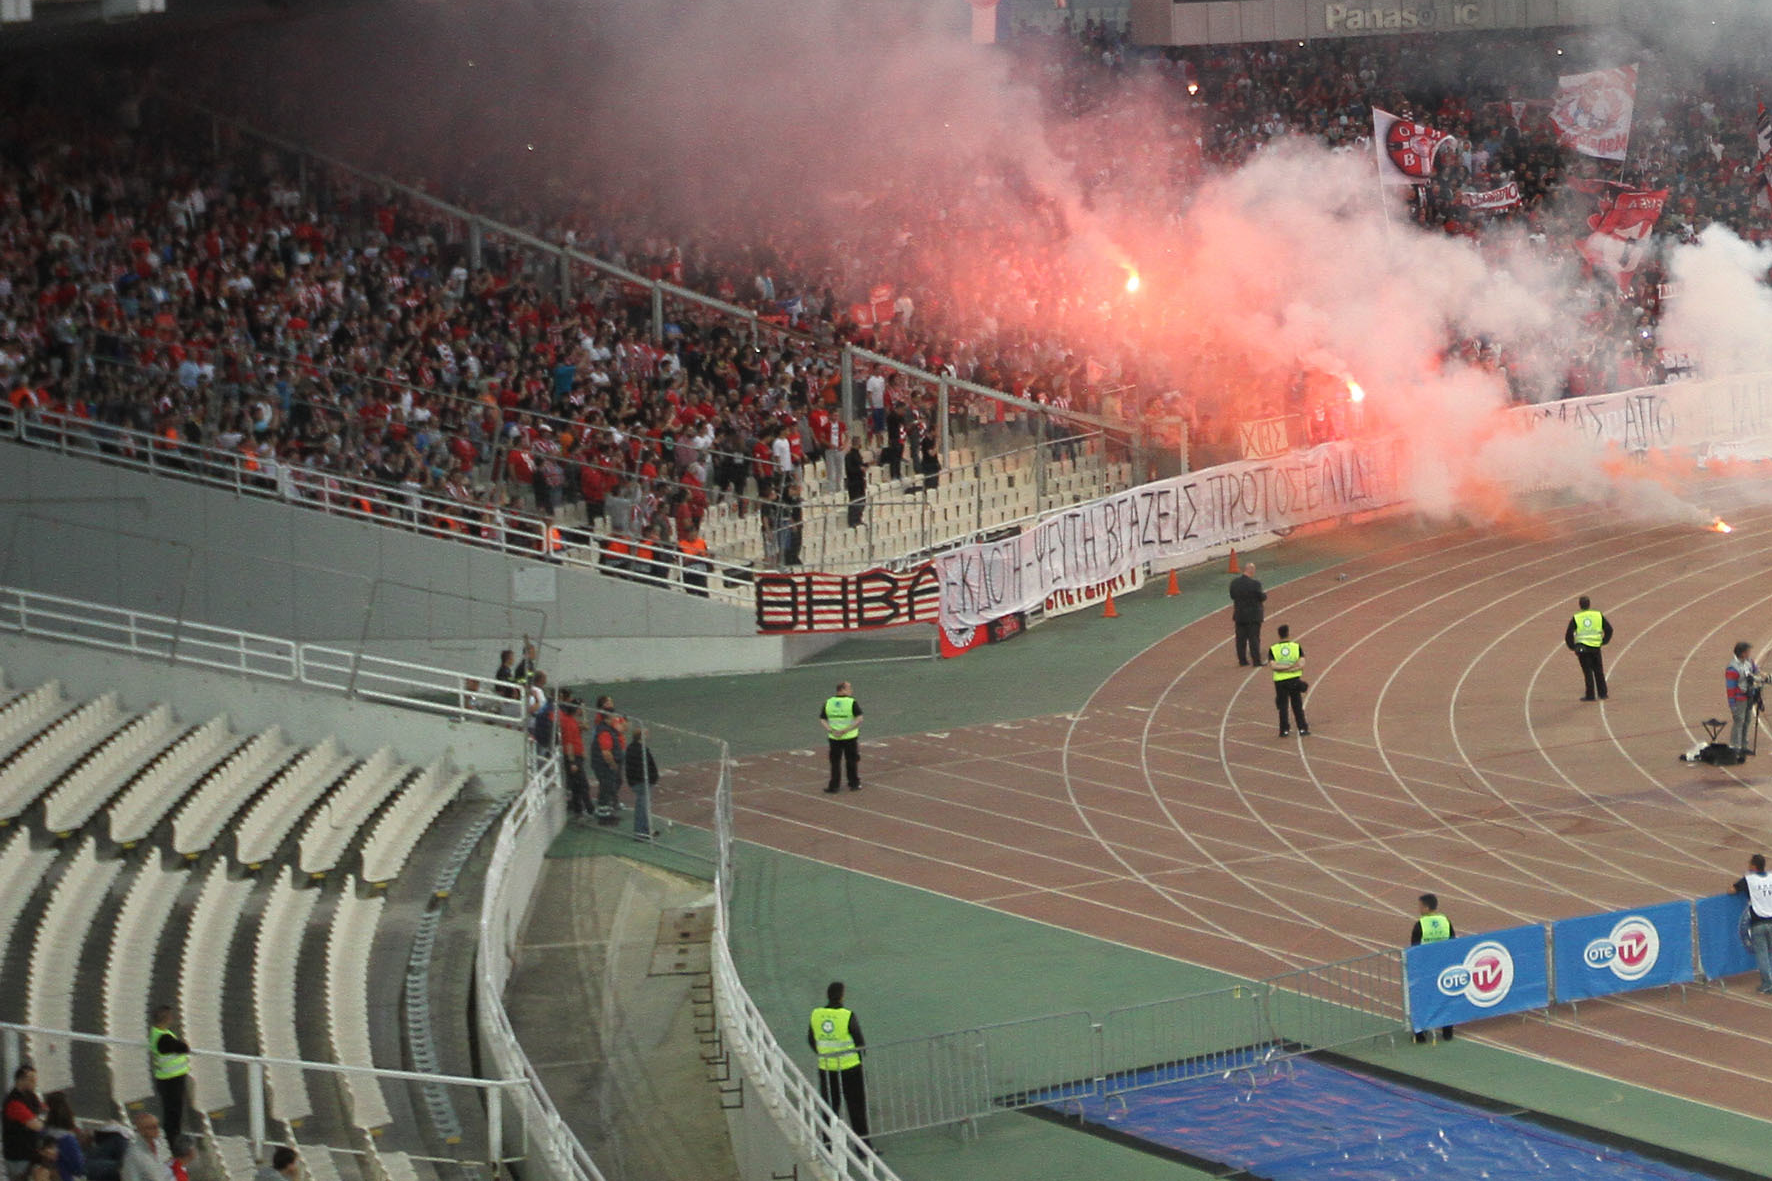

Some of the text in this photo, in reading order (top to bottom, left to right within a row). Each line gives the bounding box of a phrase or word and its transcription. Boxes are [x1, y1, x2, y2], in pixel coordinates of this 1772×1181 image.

[1325, 2, 1481, 32] Panasoic
[1103, 483, 1198, 567] ΒΓΑΖΕΙΣ
[1589, 937, 1649, 962] OTE TV
[1443, 962, 1503, 989] OTE TV
